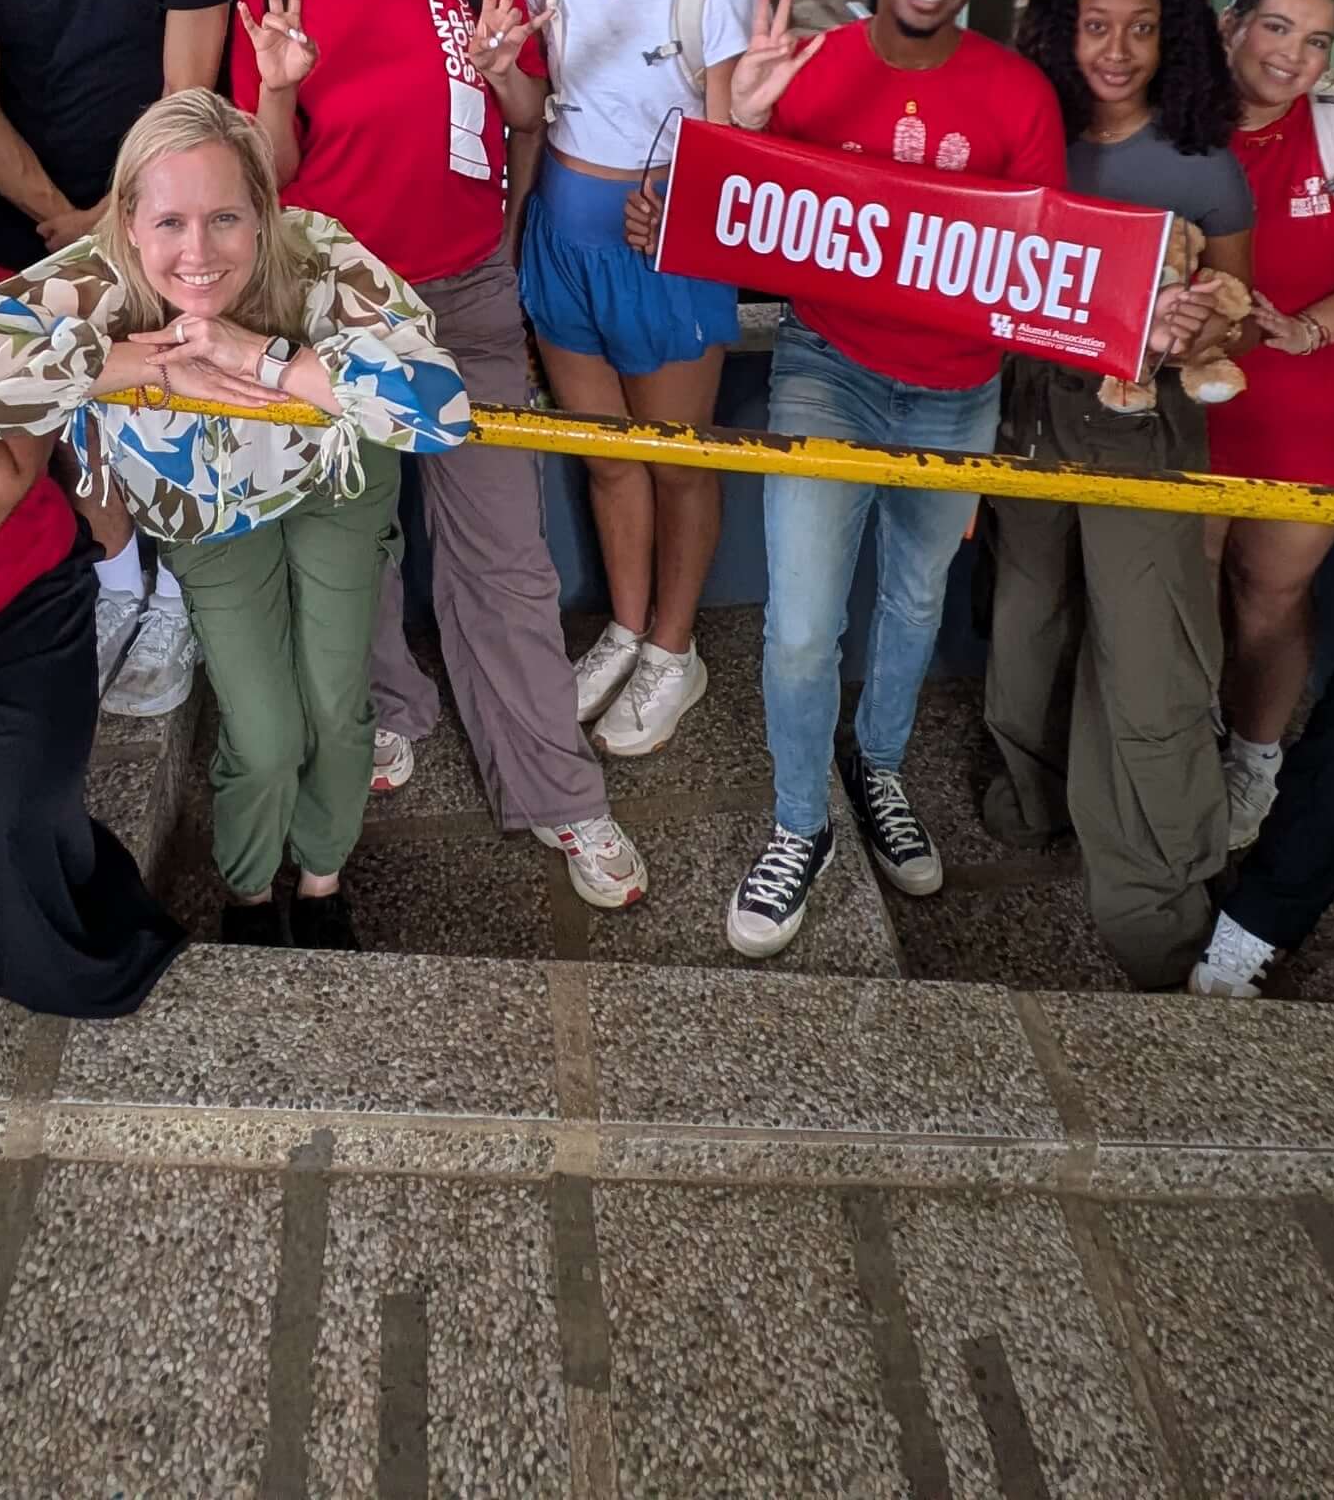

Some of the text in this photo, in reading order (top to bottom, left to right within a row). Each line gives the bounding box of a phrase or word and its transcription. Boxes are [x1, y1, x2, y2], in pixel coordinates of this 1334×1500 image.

[447, 8, 476, 84] STOP
[715, 173, 1103, 325] COOGS HOUSE!
[1015, 334, 1056, 350] UNIVERSITY
[1017, 322, 1107, 350] Alumni Association
